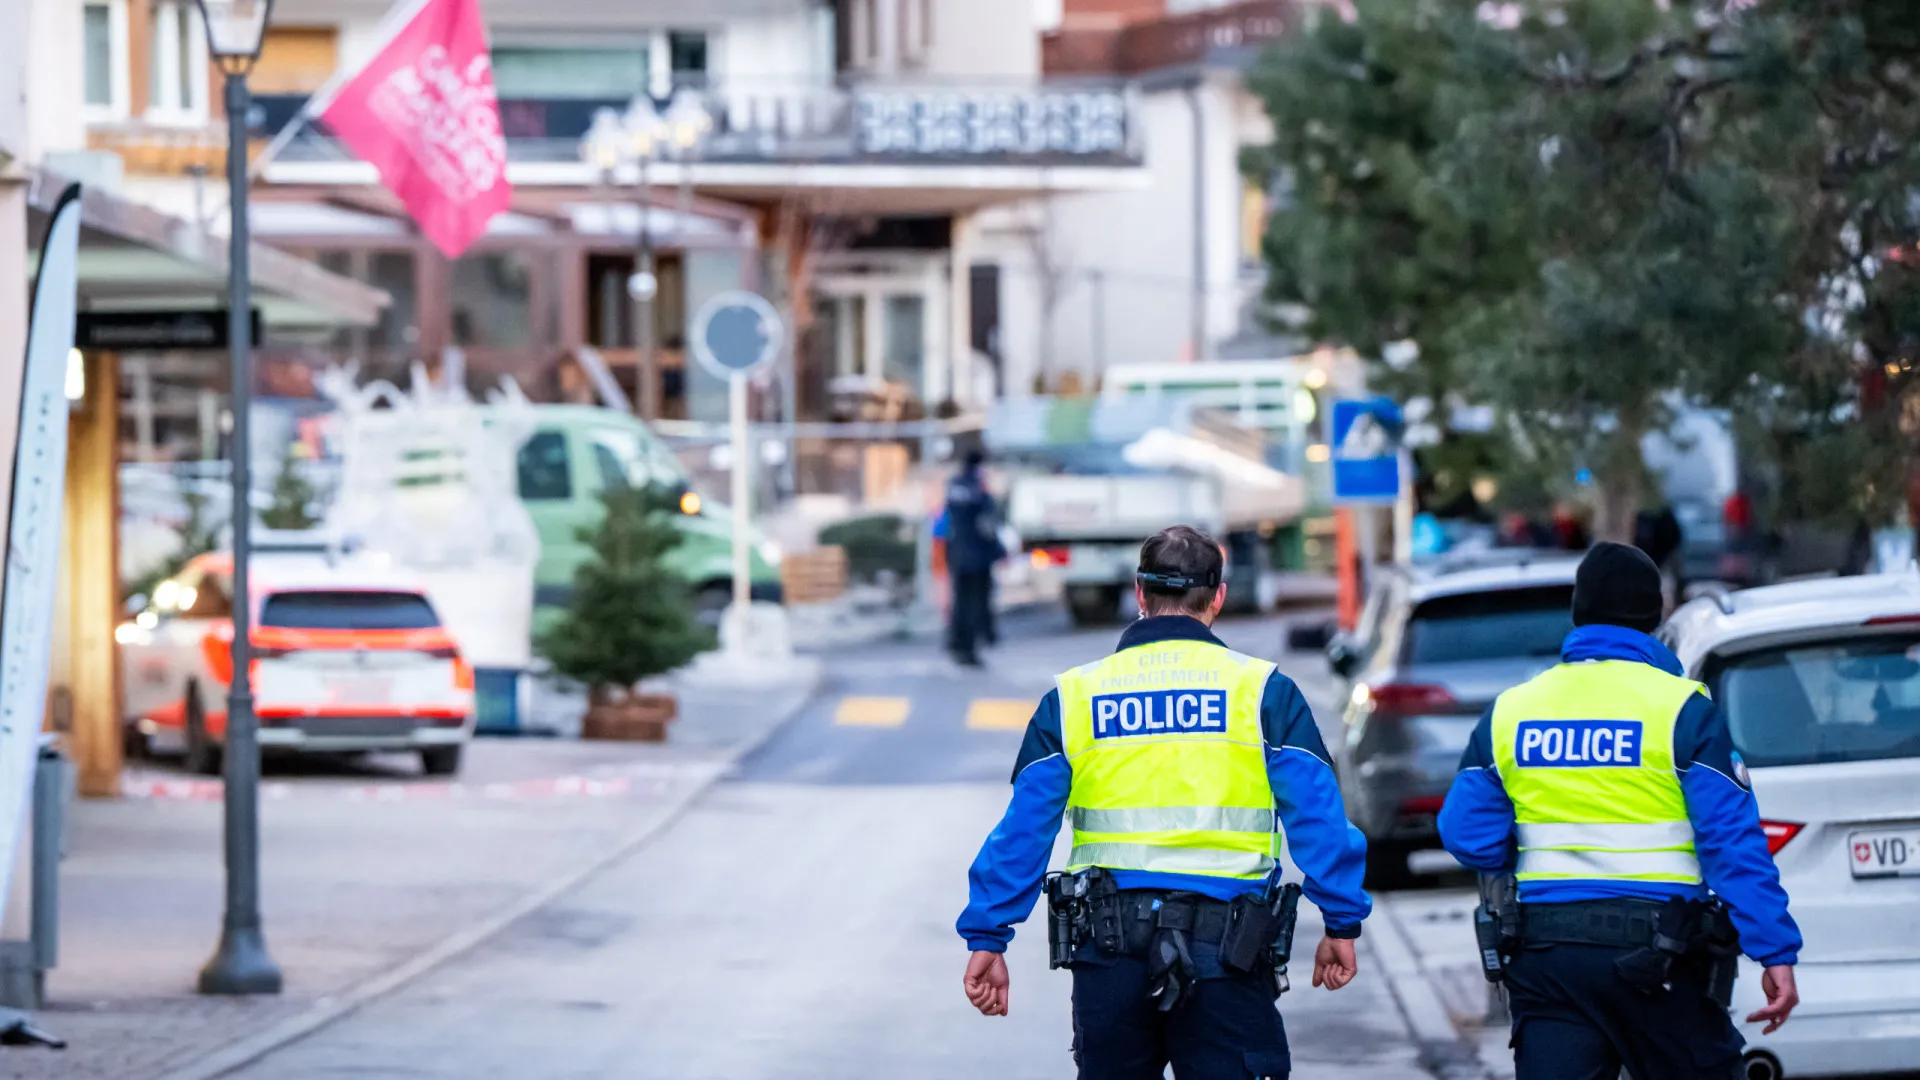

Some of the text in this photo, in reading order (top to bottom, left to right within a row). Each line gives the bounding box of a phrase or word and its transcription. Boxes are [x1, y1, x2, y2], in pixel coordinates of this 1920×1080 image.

[1139, 652, 1183, 667] CHEF
[1102, 671, 1219, 689] ENGAGEMENT
[1098, 694, 1221, 733] POLICE
[1522, 728, 1634, 763] POLICE
